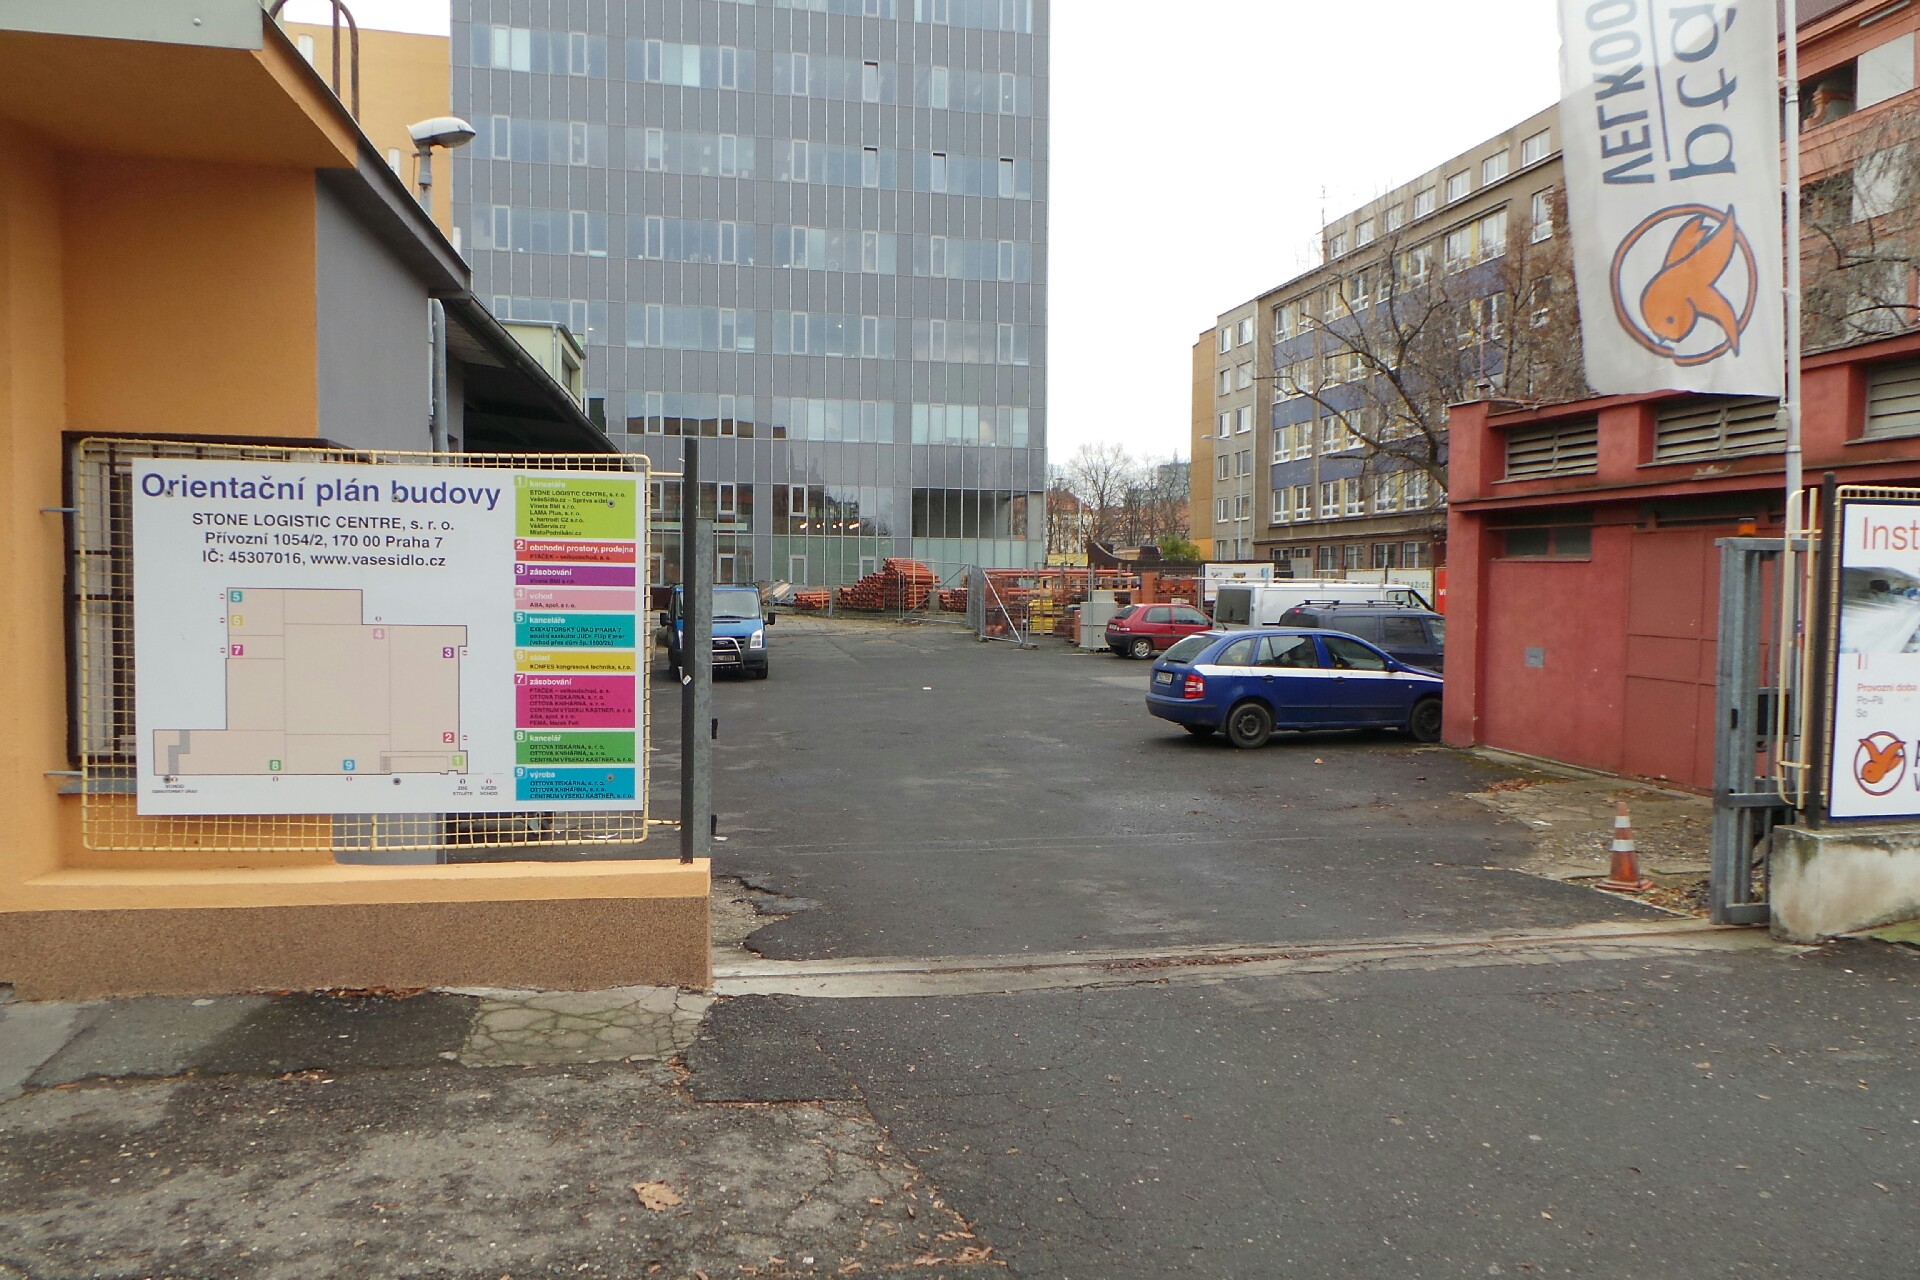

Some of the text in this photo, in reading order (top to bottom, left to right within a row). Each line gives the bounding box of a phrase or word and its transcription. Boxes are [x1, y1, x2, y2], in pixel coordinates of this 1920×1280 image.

[142, 472, 501, 510] Orientační plán budovy
[192, 512, 455, 531] STONE LOGISTIC CENTRE, s. r. o.
[205, 531, 443, 548] Přívozní 1054/2, 170 00 Praha 7
[202, 549, 446, 567] IČ: 45307016, www.vasesidlo.cz
[516, 565, 523, 573] 3
[233, 592, 240, 602] 5
[233, 616, 240, 626] 6
[516, 613, 522, 622] 5
[375, 629, 382, 639] 4
[233, 646, 241, 655] 7
[445, 648, 452, 658] 3
[516, 651, 523, 659] 6
[517, 675, 523, 683] 7
[1858, 683, 1917, 692] Provozní doba
[445, 733, 452, 742] 2
[516, 732, 523, 740] 8
[345, 760, 353, 770] 9
[454, 756, 461, 765] 1
[271, 761, 279, 770] 8
[516, 768, 523, 776] 9
